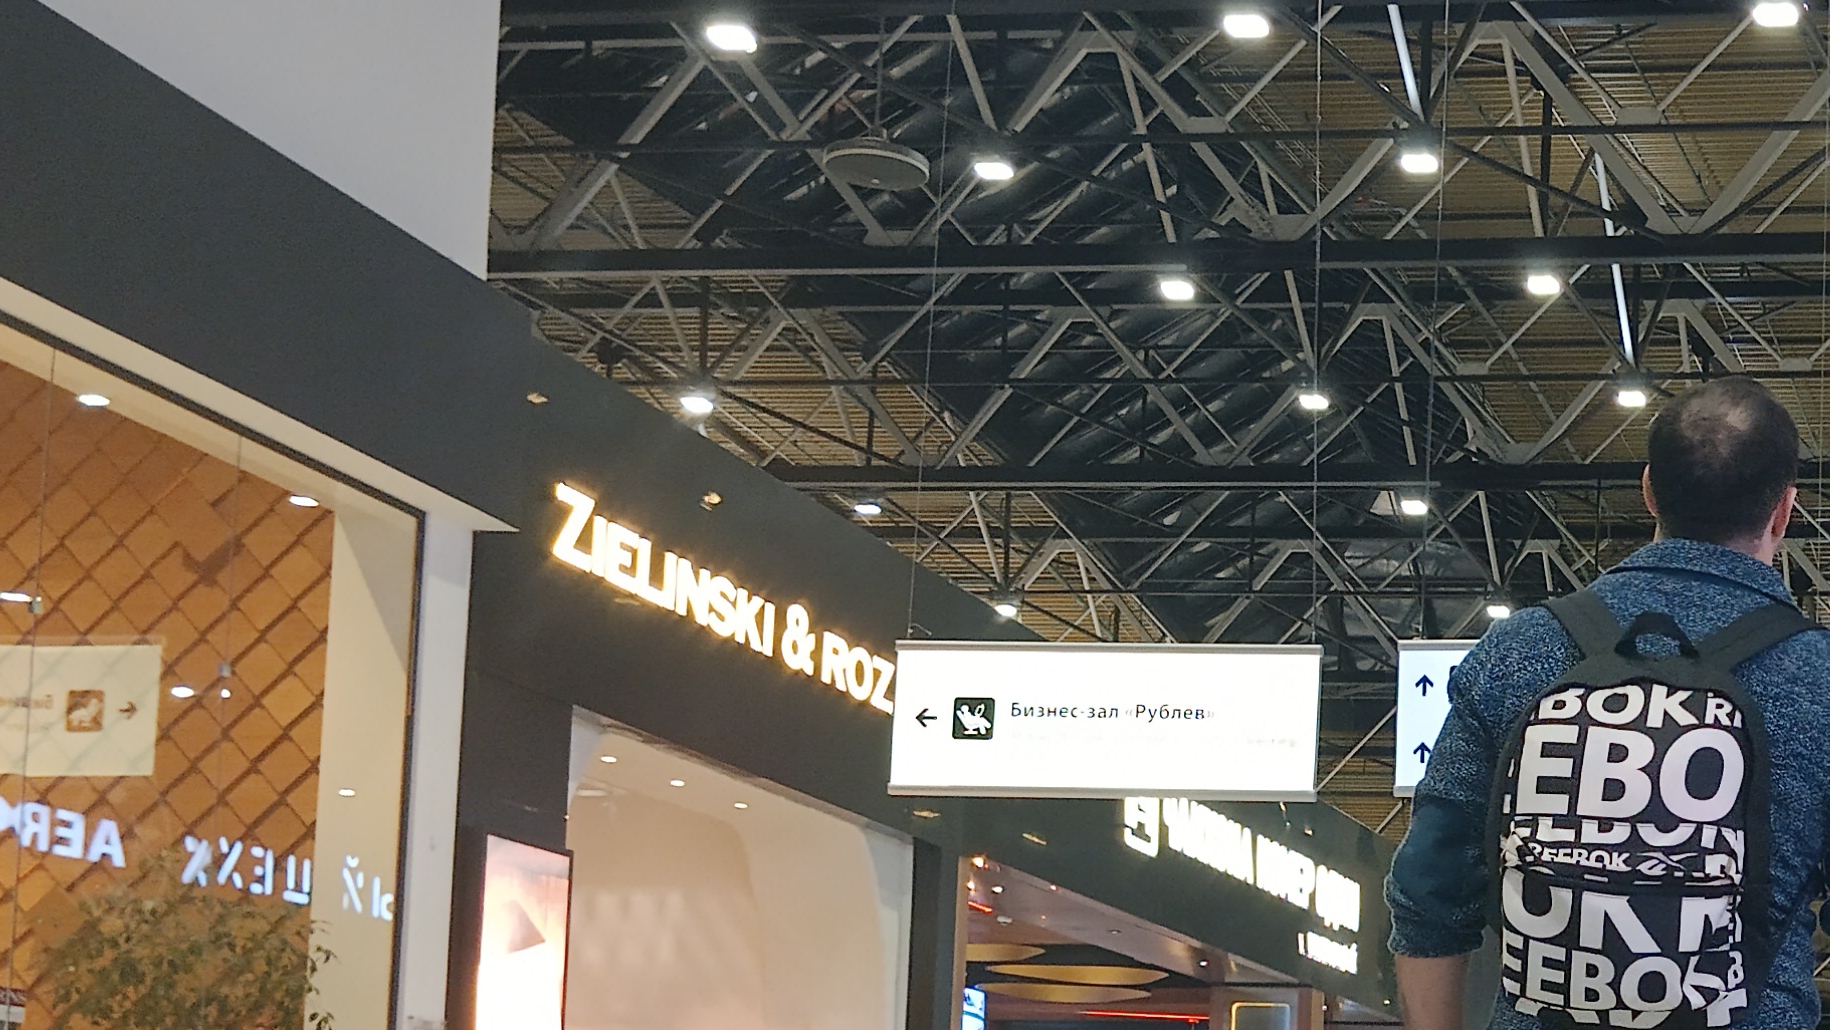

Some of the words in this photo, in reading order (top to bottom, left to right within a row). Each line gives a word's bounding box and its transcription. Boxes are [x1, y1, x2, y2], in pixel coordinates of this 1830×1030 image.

[552, 482, 775, 657] ZIELINSKI
[781, 603, 815, 677] &
[1010, 702, 1119, 719] Бизнес-зал
